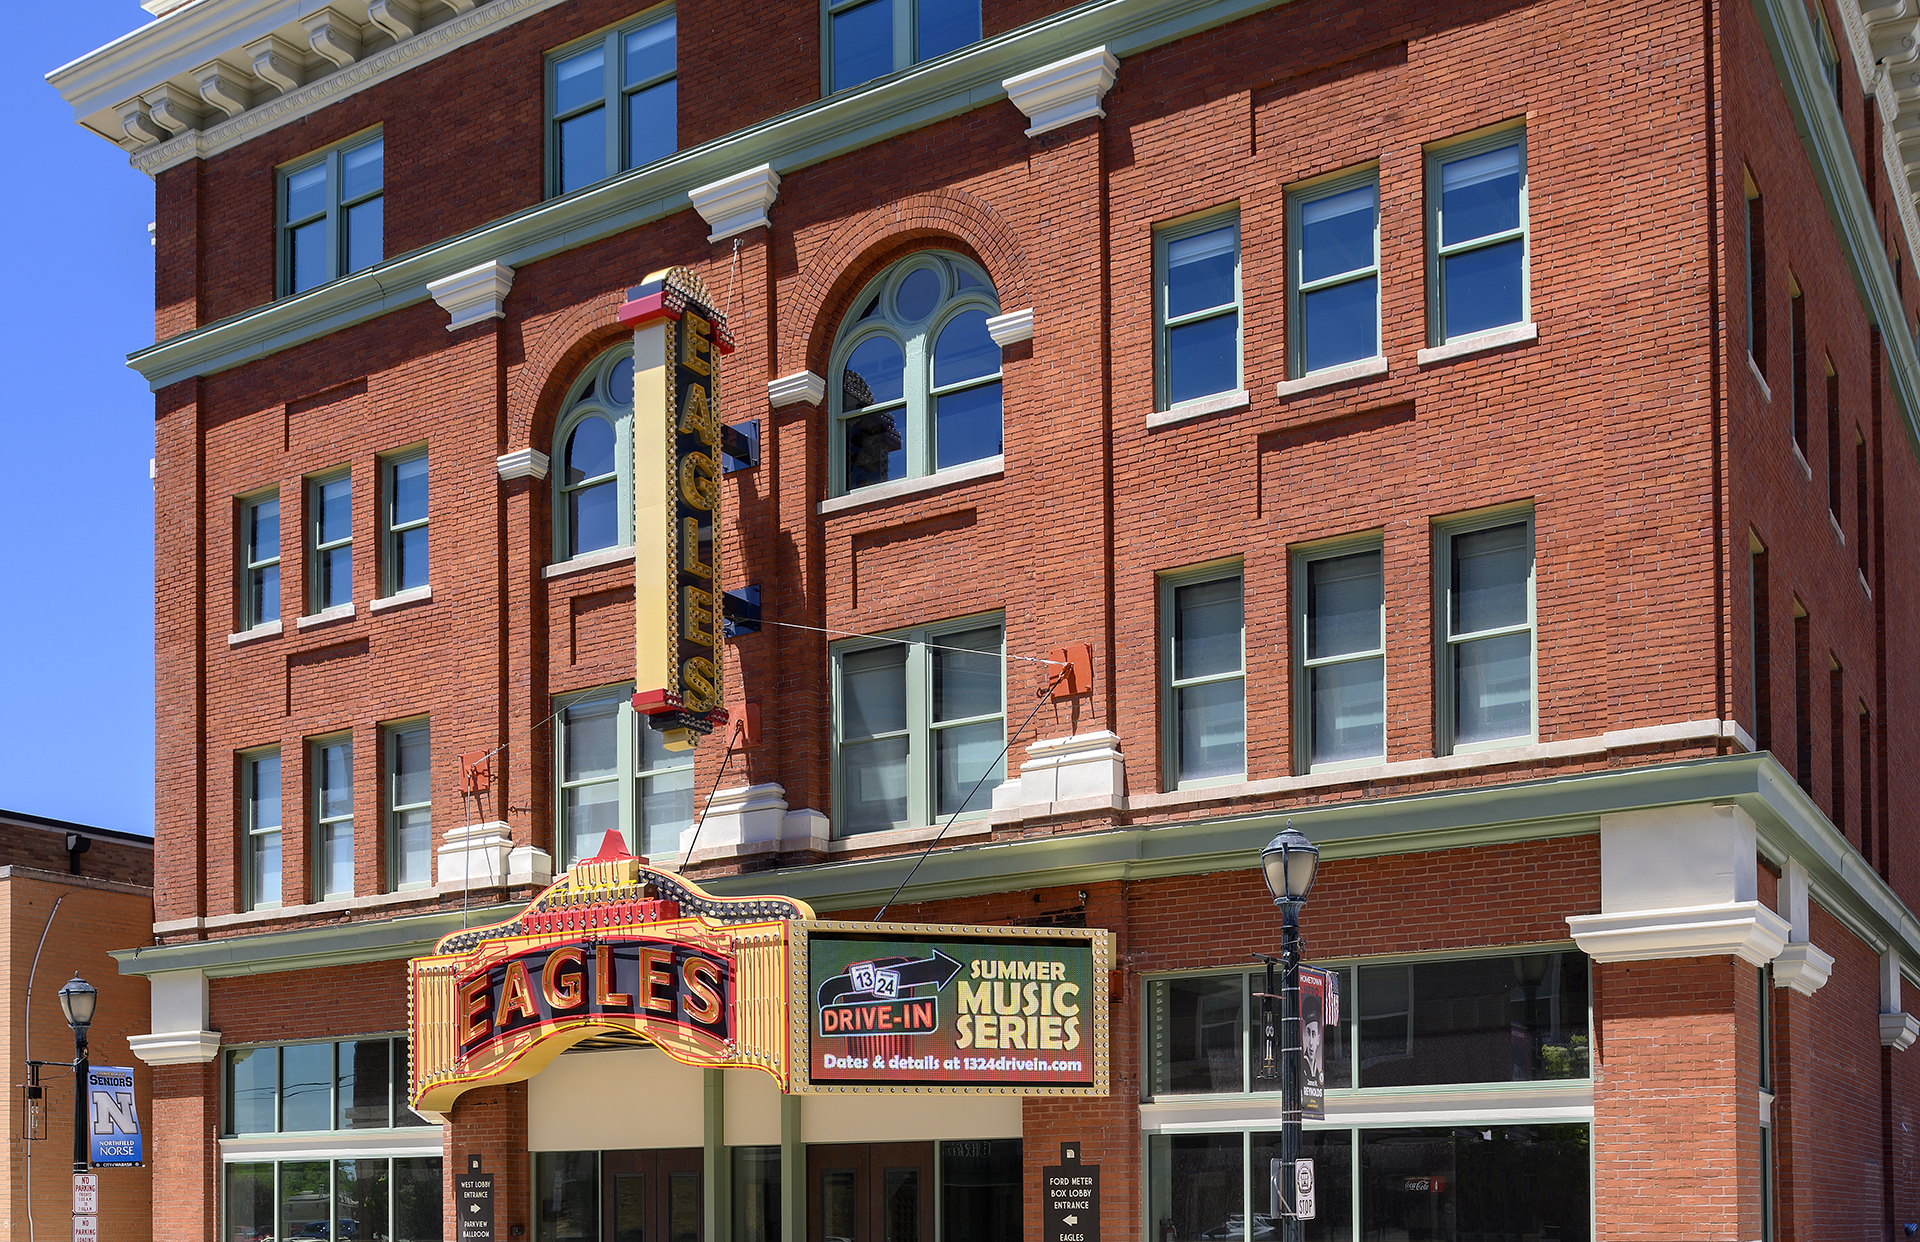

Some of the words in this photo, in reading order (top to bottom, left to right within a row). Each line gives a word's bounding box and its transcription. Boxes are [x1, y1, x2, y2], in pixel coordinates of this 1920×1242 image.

[678, 310, 715, 713] EAGLES
[970, 959, 1066, 981] SUMMER
[856, 971, 873, 988] 13
[876, 978, 895, 995] 24
[1300, 974, 1323, 986] HOMETOWN
[460, 945, 723, 1047] EAGLES
[1303, 985, 1320, 997] HERO
[957, 980, 1080, 1017] MUSIC
[823, 1002, 933, 1032] DRIVE-IN
[955, 1014, 1081, 1051] SERIES
[823, 1053, 869, 1069] Dates
[872, 1054, 886, 1070] &
[888, 1054, 940, 1070] details
[943, 1056, 961, 1070] at
[963, 1056, 1082, 1072] 1324drivein.com
[89, 1074, 133, 1087] SENIORS
[92, 1091, 138, 1134] N
[99, 1146, 135, 1156] NORSE
[1049, 1177, 1070, 1186] FORD
[1071, 1177, 1093, 1186] METER
[463, 1191, 488, 1199] ENTRANCE
[1050, 1189, 1067, 1198] BOX
[1068, 1189, 1092, 1198] LOBBY
[1054, 1201, 1089, 1209] ENTRANCE
[1299, 1199, 1313, 1214] STOP
[464, 1220, 488, 1228] PARKVIEW
[462, 1230, 490, 1238] BALLROOM
[1059, 1233, 1084, 1242] EAGLES
